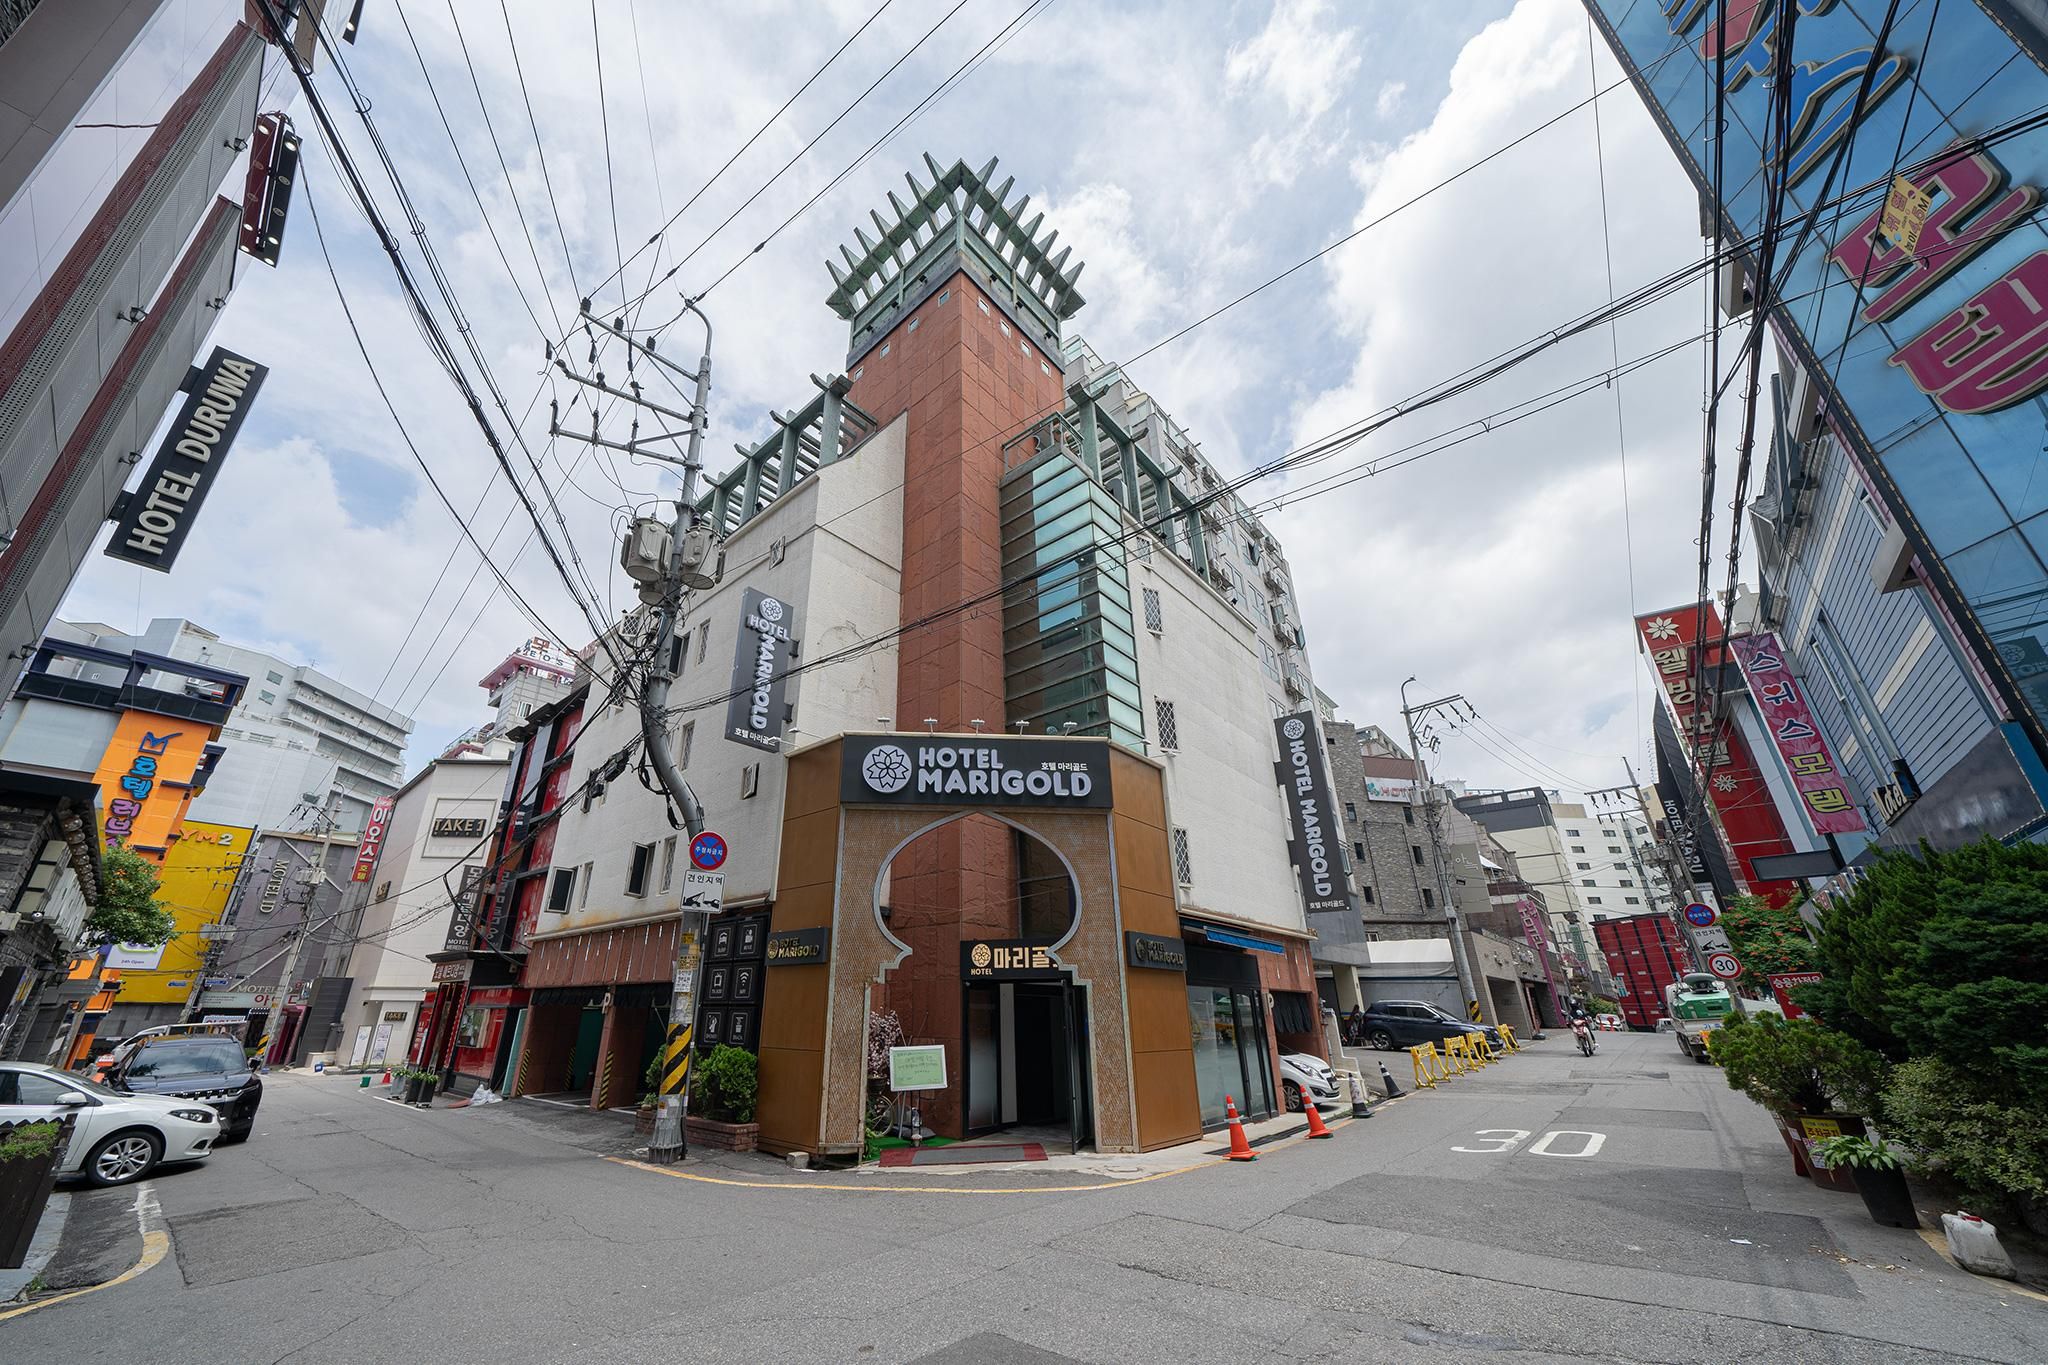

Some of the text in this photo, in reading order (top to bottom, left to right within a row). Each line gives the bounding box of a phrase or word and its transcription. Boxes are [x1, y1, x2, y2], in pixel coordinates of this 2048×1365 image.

[126, 357, 256, 556] HOTEL DURUWA
[747, 614, 790, 642] HOTEL
[751, 633, 776, 730] MARIGOLD
[735, 728, 748, 738] 호텔
[918, 747, 1004, 770] HOTEL
[1041, 762, 1088, 772] 호텔 마리골드
[917, 768, 1092, 797] MARIGOLD
[1789, 752, 1853, 814] 모텔
[435, 819, 475, 831] TAKE
[1289, 740, 1333, 897] HOTEL MARIGOLD
[1664, 800, 1683, 831] HOTEL
[359, 807, 388, 862] 이오스
[260, 859, 289, 913] MOTEL ID
[687, 874, 723, 885] 견인지역
[1520, 908, 1544, 950] HOTEL
[778, 944, 820, 958] MARIGOLD
[994, 946, 1058, 969] 마리골
[970, 968, 993, 976] HOTEL
[1715, 960, 1735, 972] 30
[602, 992, 610, 1014] P
[1451, 1129, 1607, 1157] 30
